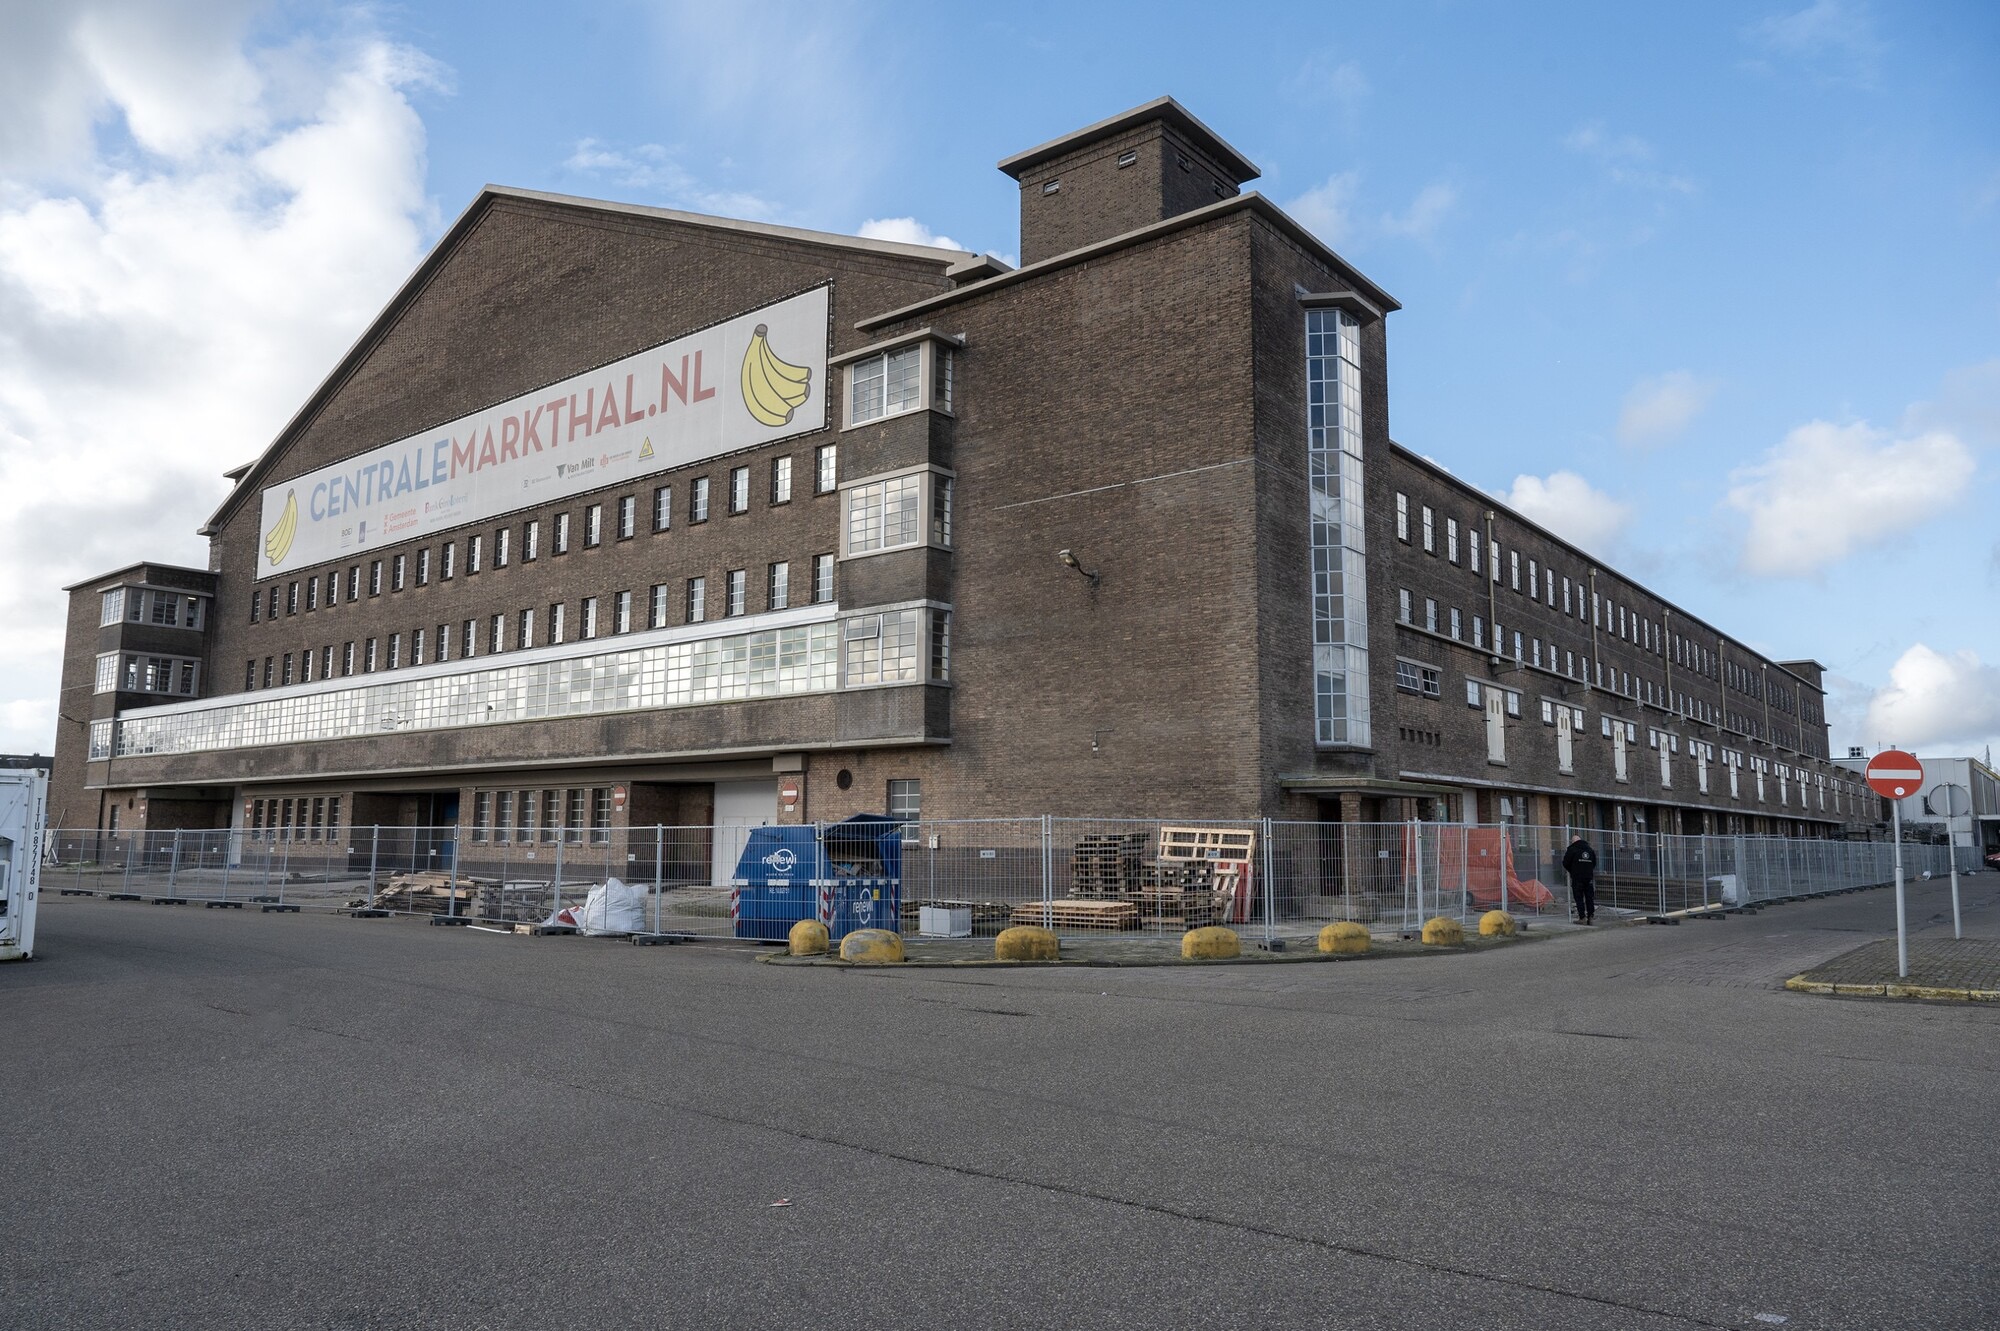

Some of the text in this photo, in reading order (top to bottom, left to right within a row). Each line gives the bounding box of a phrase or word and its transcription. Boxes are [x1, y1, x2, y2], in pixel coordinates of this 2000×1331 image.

[310, 350, 716, 522] CENTRALEMARKTHAL.NL
[567, 462, 579, 474] Van
[581, 457, 595, 470] Milt
[389, 508, 417, 522] Gemeente
[388, 519, 418, 532] Amsterdam
[762, 854, 797, 865] renewi
